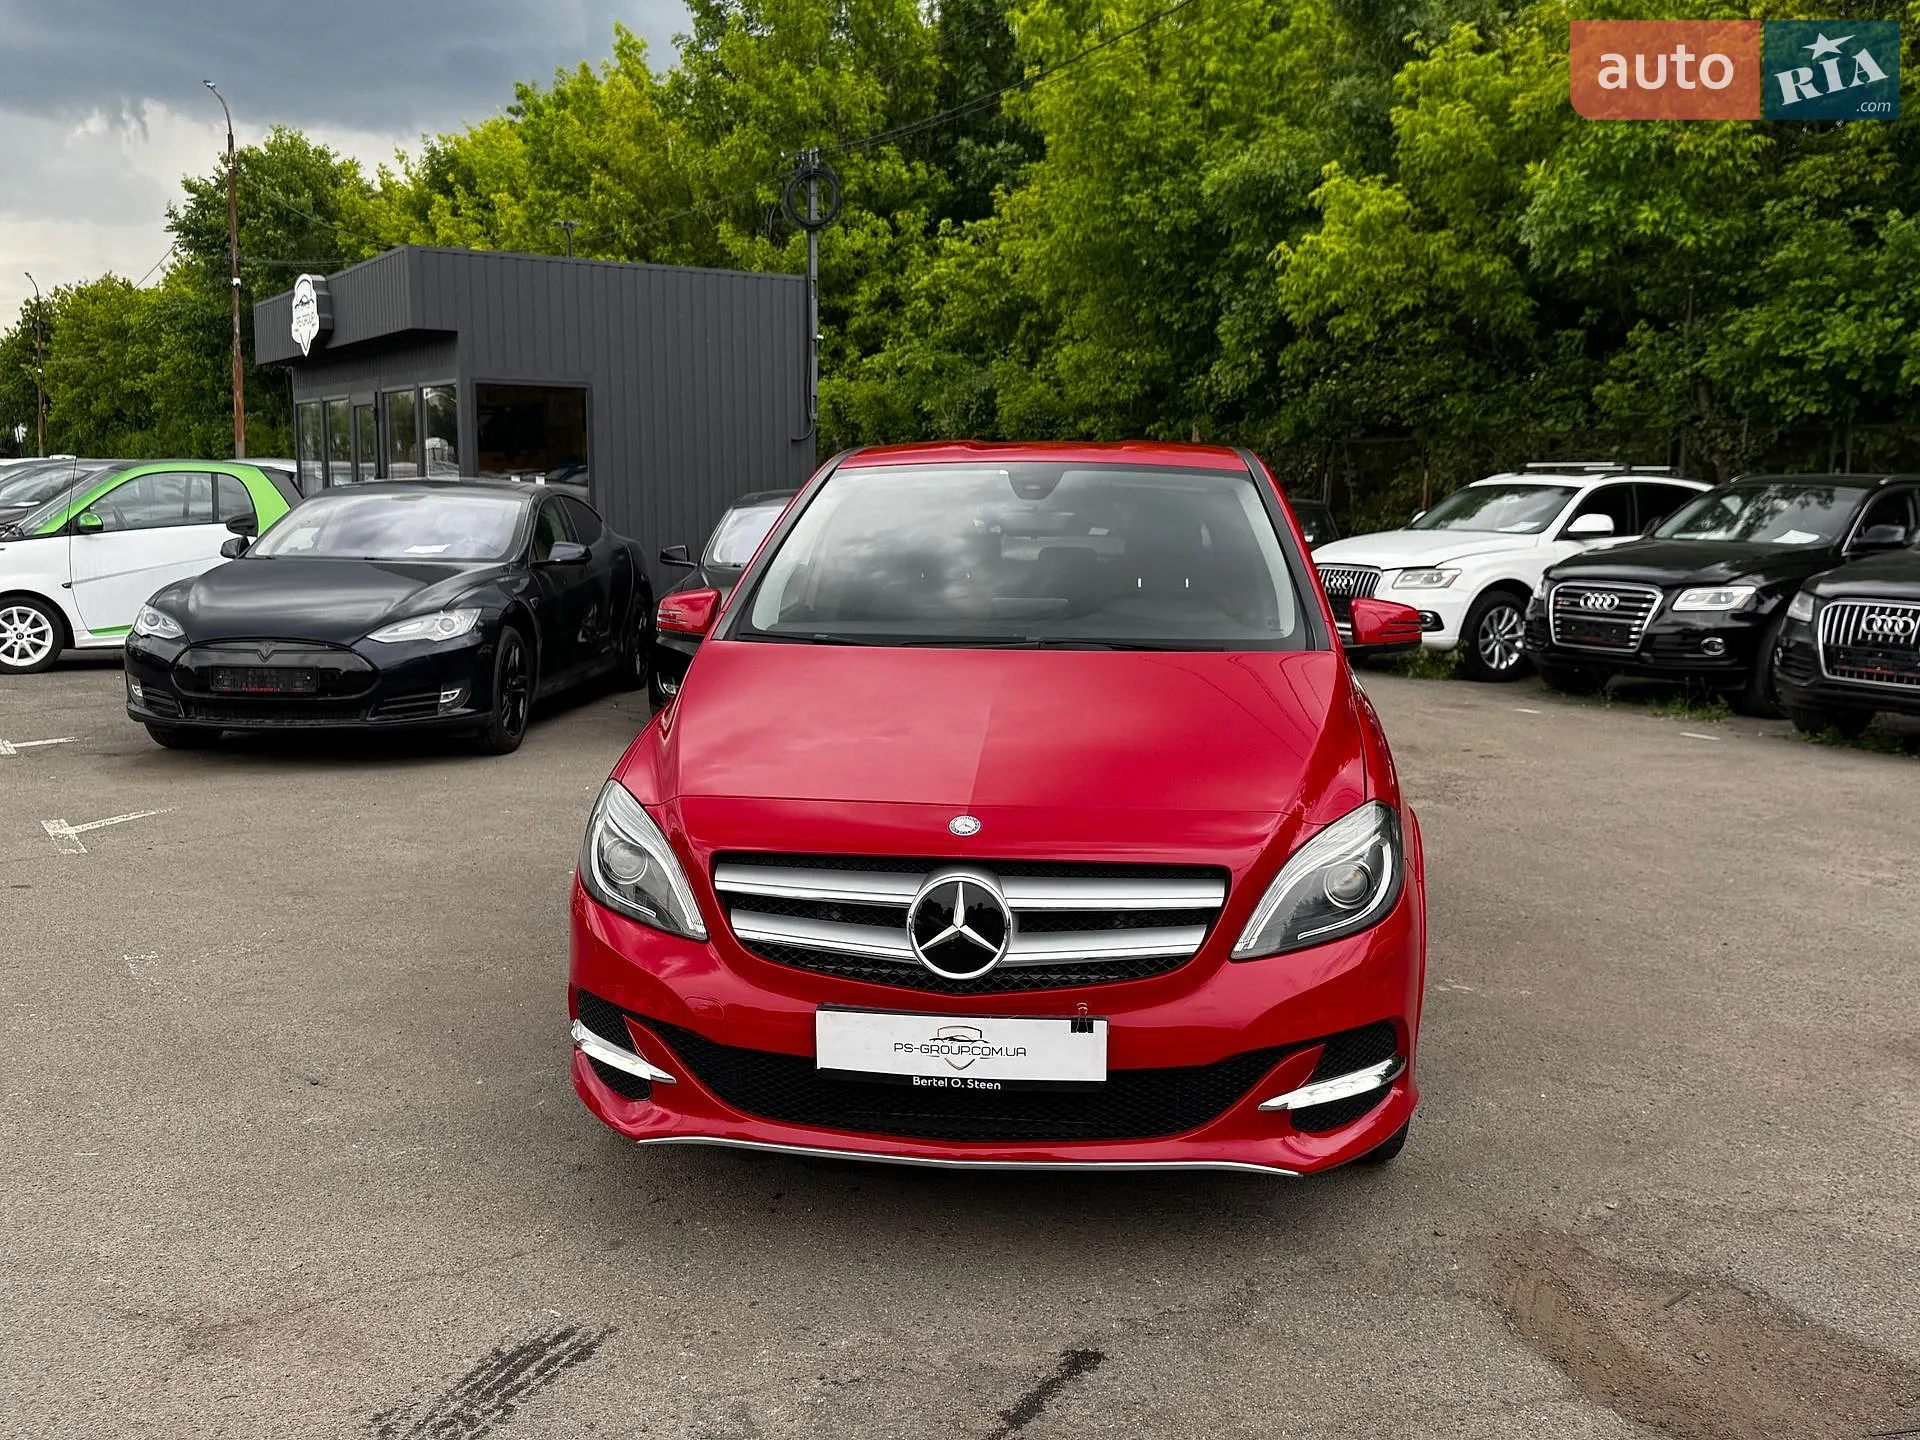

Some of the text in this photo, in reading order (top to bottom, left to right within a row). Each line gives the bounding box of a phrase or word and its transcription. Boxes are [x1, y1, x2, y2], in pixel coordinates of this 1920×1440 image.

[912, 1076, 1002, 1090] Bertel O. Steen
